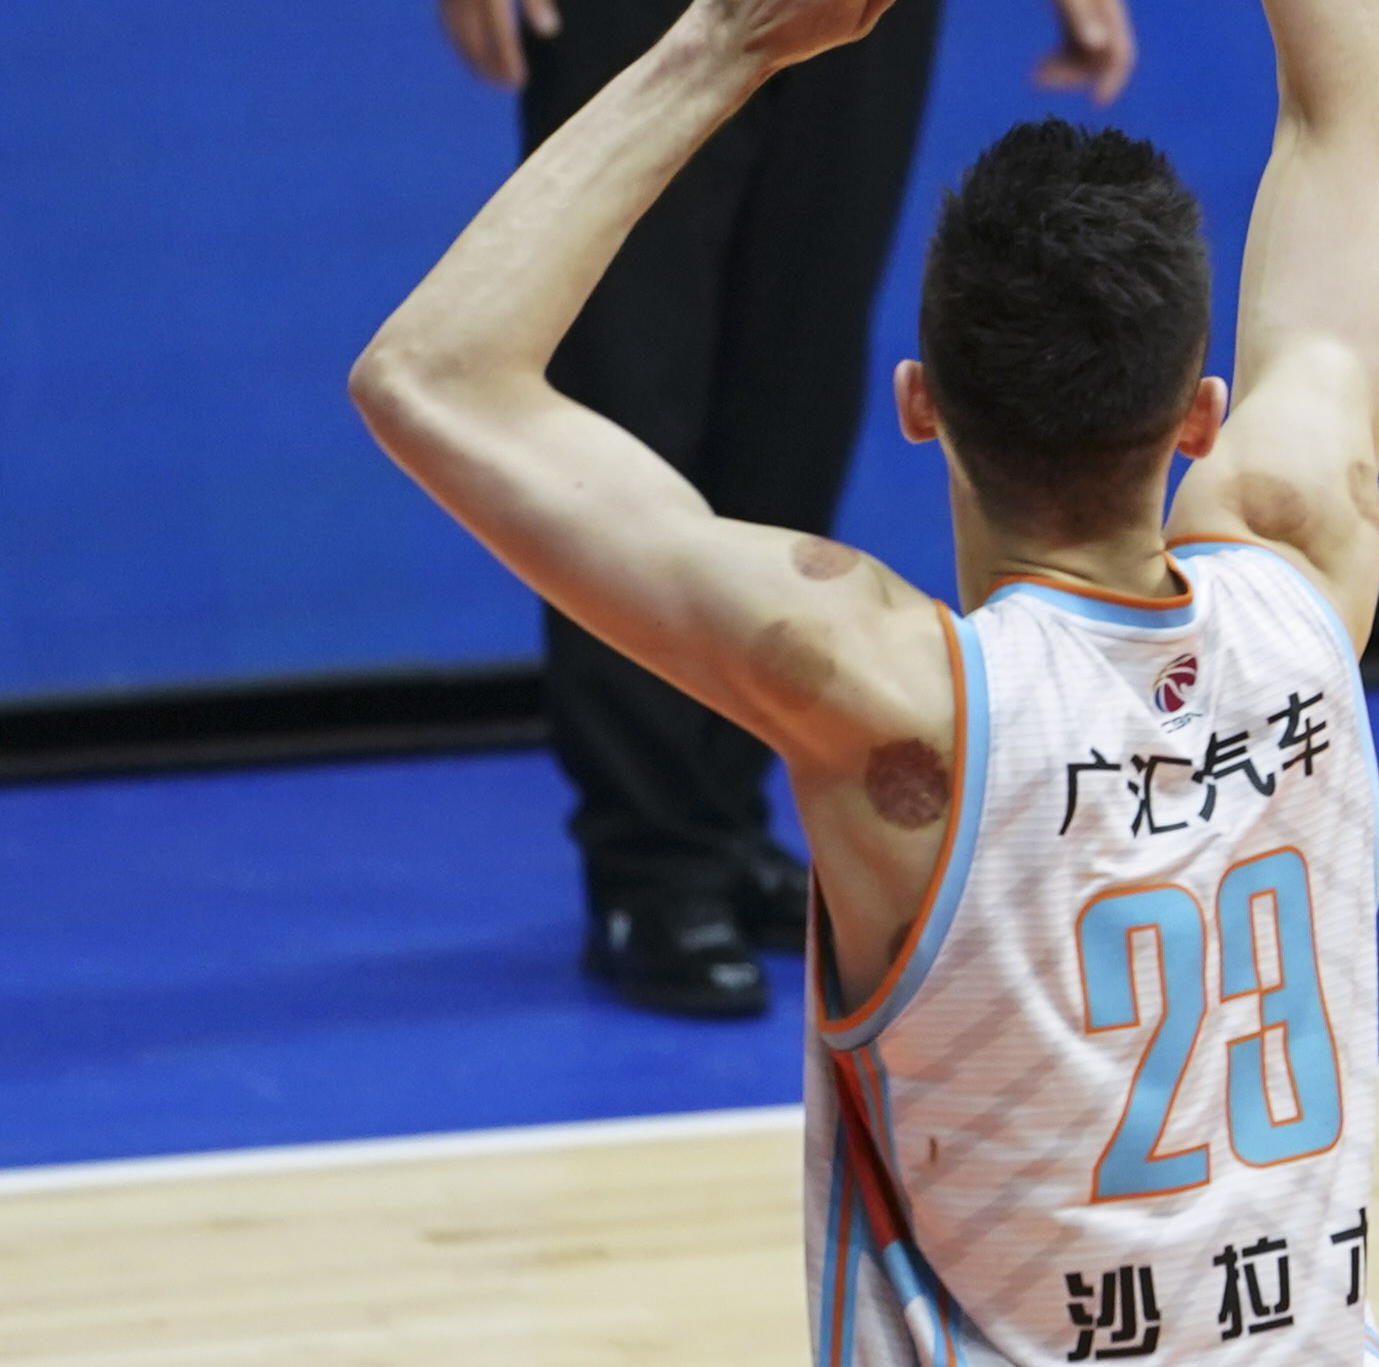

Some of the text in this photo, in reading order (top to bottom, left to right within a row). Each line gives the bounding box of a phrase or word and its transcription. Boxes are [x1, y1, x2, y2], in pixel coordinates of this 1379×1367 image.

[1058, 692, 1330, 838] 广汇汽车
[1075, 845, 1343, 1204] 23
